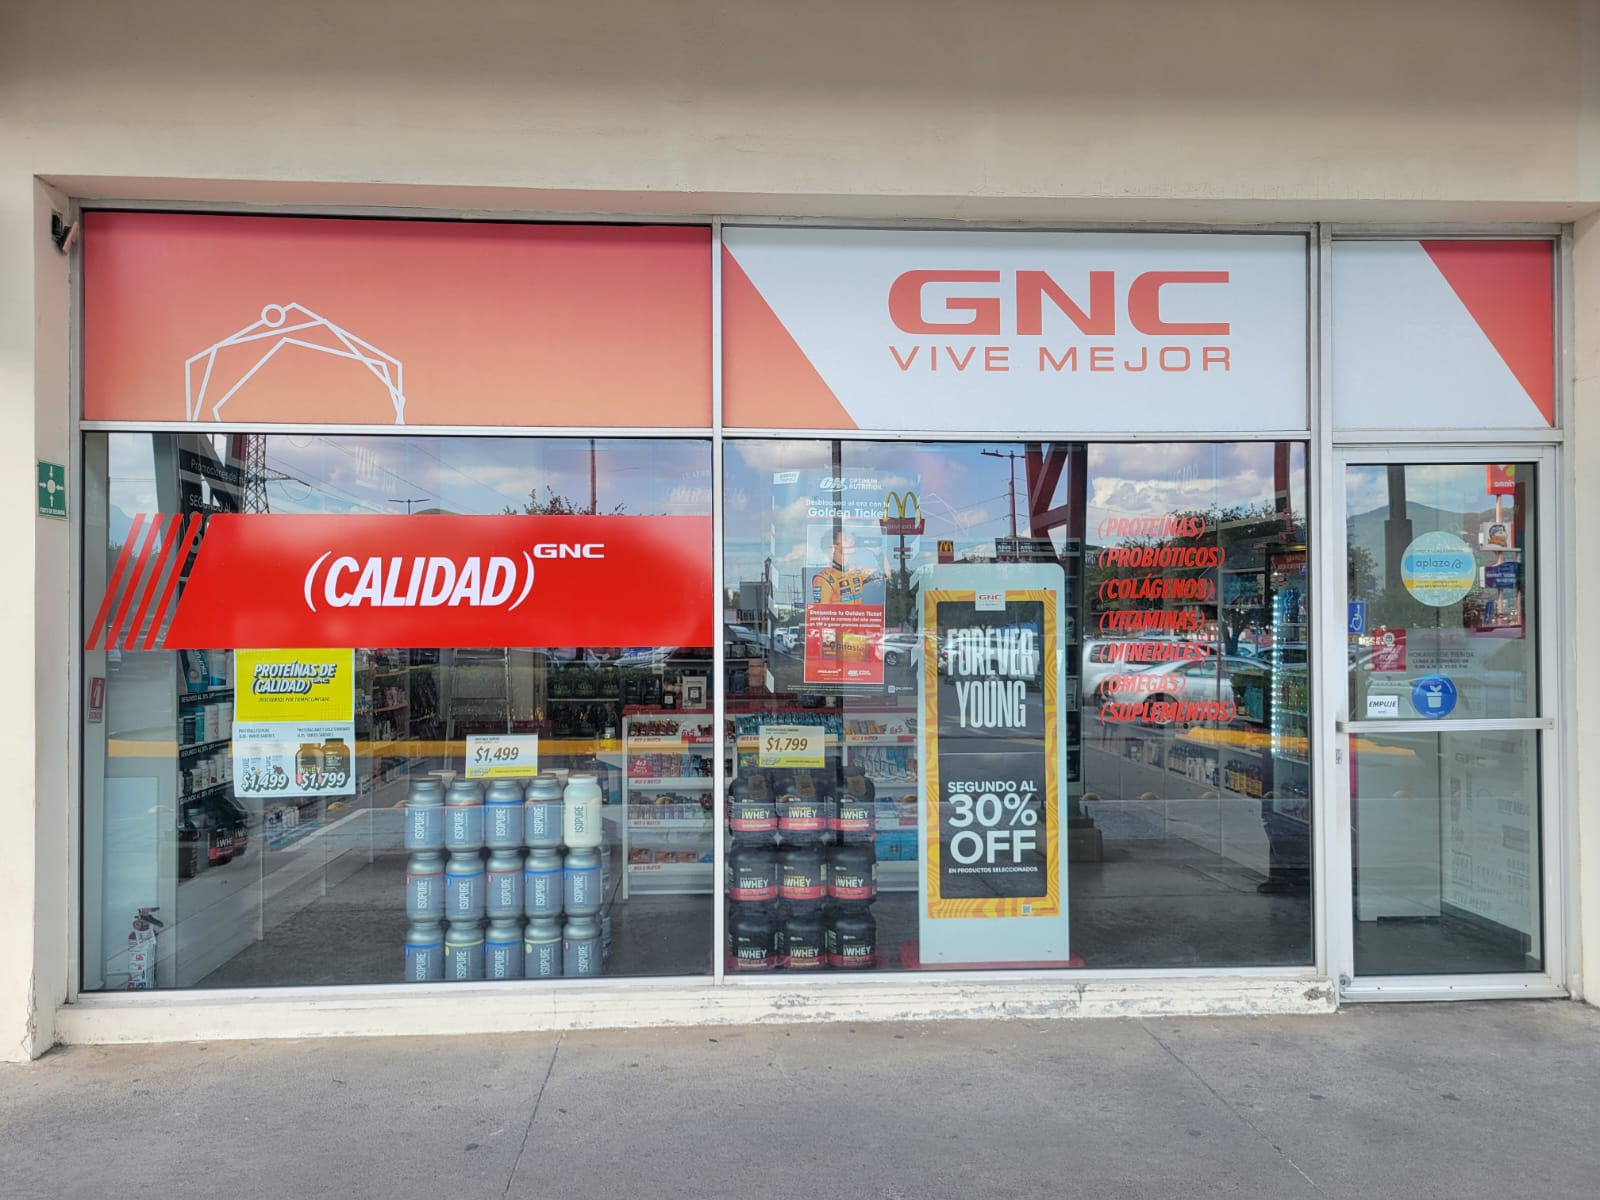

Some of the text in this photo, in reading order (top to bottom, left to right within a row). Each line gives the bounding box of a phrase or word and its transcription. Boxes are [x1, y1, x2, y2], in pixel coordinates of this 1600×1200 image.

[888, 269, 1230, 336] GNC
[888, 346, 1231, 372] VIVE MEJOR
[807, 507, 889, 518] Golden Ticket
[1098, 512, 1206, 541] (PROTEÍNAS)
[1097, 542, 1227, 570] (PROBIÓTICOS)
[1415, 558, 1450, 569] aplazo
[304, 543, 605, 613] (CALIDAD) GNC
[1098, 573, 1215, 602] (COLÁGENOS)
[1099, 609, 1206, 633] (VITAMINAS)
[947, 627, 1035, 677] FOREVER
[1100, 641, 1211, 664] (MINERALES)
[253, 659, 337, 678] PROTEÍNAS DE
[251, 678, 312, 695] (CALIDAD)
[1100, 673, 1187, 698] (OMEGAS)
[955, 680, 1027, 728] YOUNG
[1100, 700, 1237, 725] (SUPLEMENTOS)
[1368, 700, 1396, 708] EMPUJE
[474, 745, 519, 763] $1,499
[766, 736, 808, 752] $1,799
[242, 772, 289, 792] $1,499
[301, 772, 347, 791] $1,799
[947, 780, 1038, 793] SEGUNDO AL
[415, 808, 425, 839] ISOPURE
[496, 808, 506, 836] ISOPURE
[534, 806, 544, 834] ISOPURE
[574, 805, 585, 833] ISOPURE
[746, 810, 770, 819] WHEY
[792, 809, 817, 819] WHEY
[844, 810, 869, 819] WHEY
[948, 793, 1038, 827] 30%
[455, 811, 465, 839] ISOPURE
[950, 829, 1037, 864] OFF
[417, 881, 427, 909] ISOPURE
[459, 881, 470, 910] ISOPURE
[501, 877, 512, 905] ISOPURE
[535, 878, 545, 906] ISOPURE
[573, 875, 583, 903] ISOPURE
[744, 879, 769, 889] WHEY
[788, 878, 812, 887] WHEY
[839, 878, 864, 888] WHEY
[456, 951, 467, 979] ISOPURE
[495, 949, 505, 978] ISOPURE
[540, 947, 550, 976] ISOPURE
[578, 945, 588, 973] ISOPURE
[742, 949, 768, 959] WHEY
[794, 948, 819, 958] WHEY
[846, 946, 871, 957] WHEY
[416, 952, 426, 981] ISOPURE
